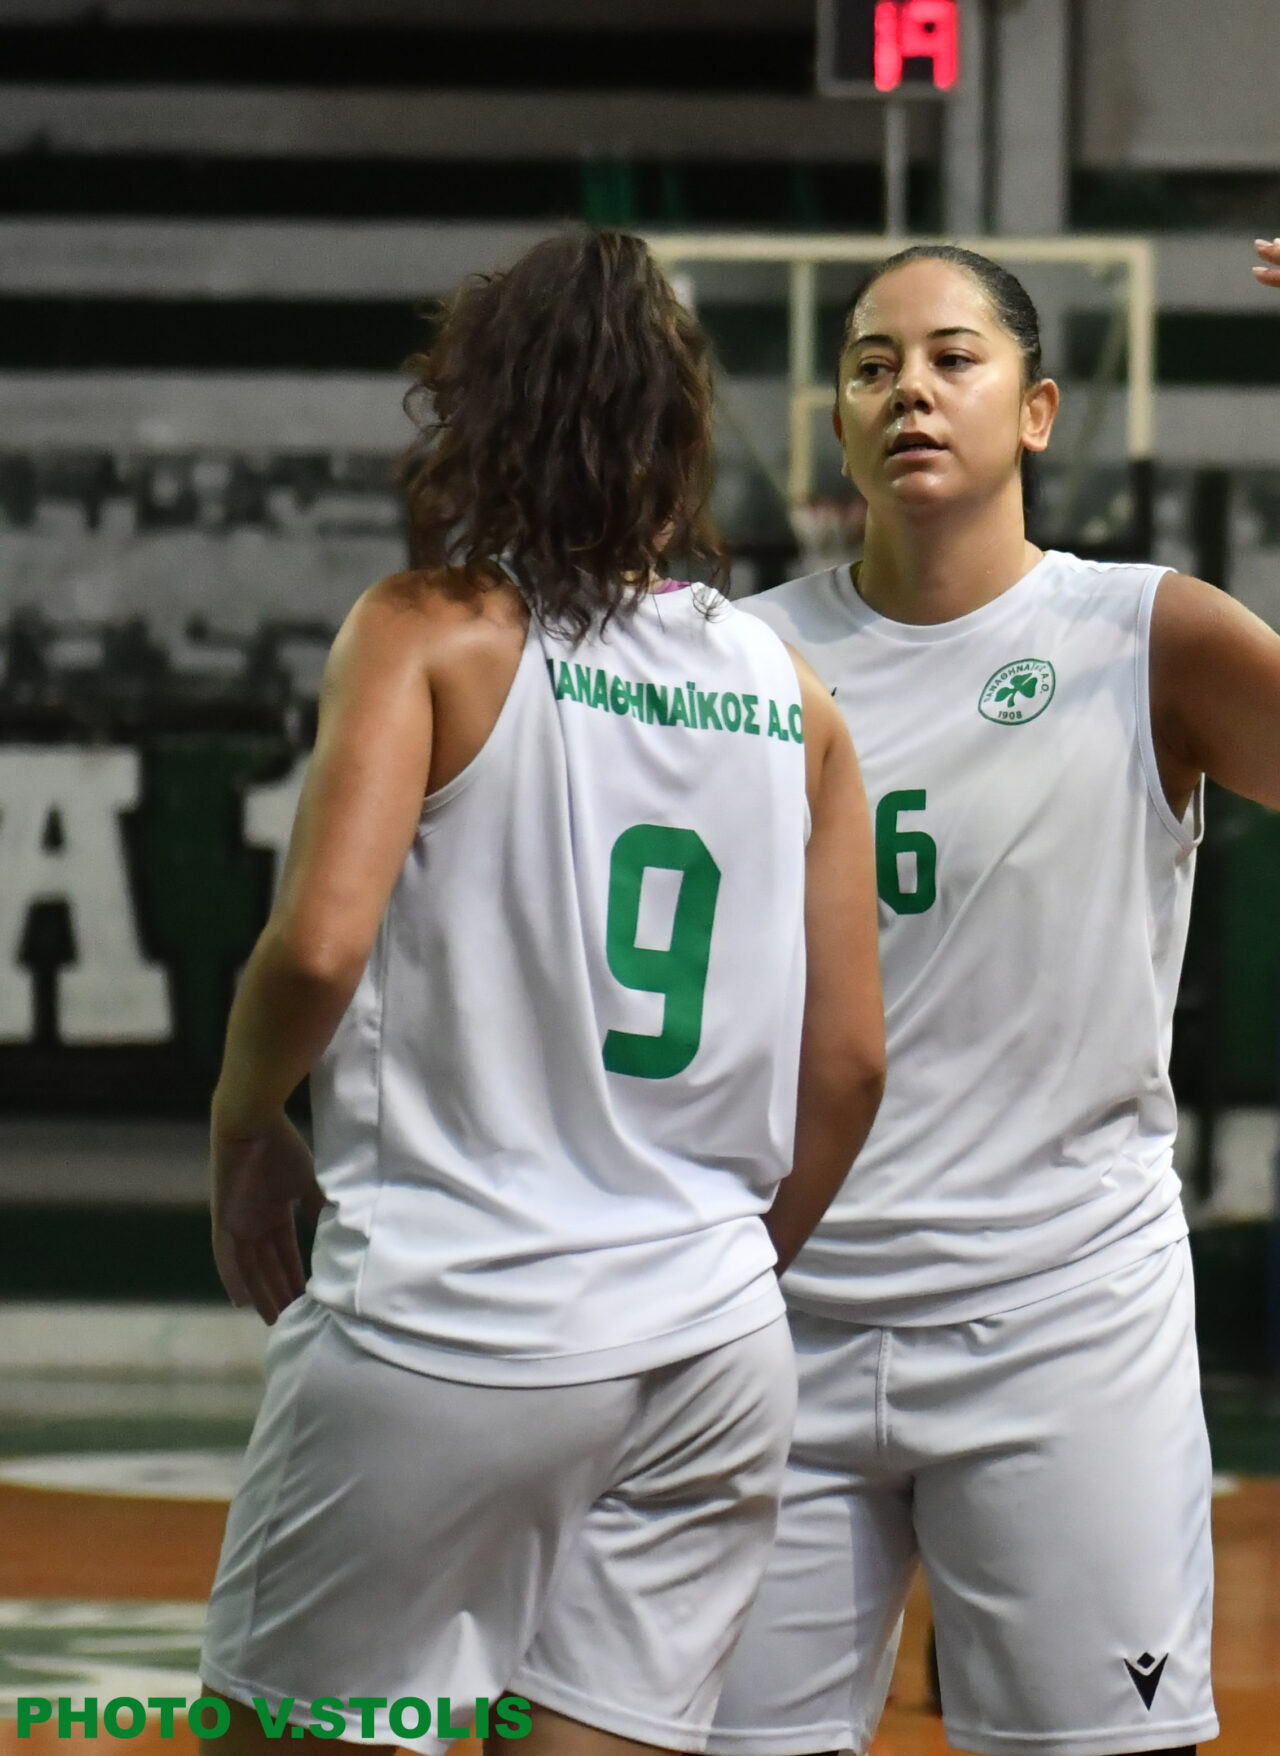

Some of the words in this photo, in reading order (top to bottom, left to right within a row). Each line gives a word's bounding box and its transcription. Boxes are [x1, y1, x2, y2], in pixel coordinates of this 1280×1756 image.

[874, 0, 957, 91] 19
[998, 711, 1023, 720] 1908
[876, 789, 937, 916] 6
[602, 823, 722, 1080] 9
